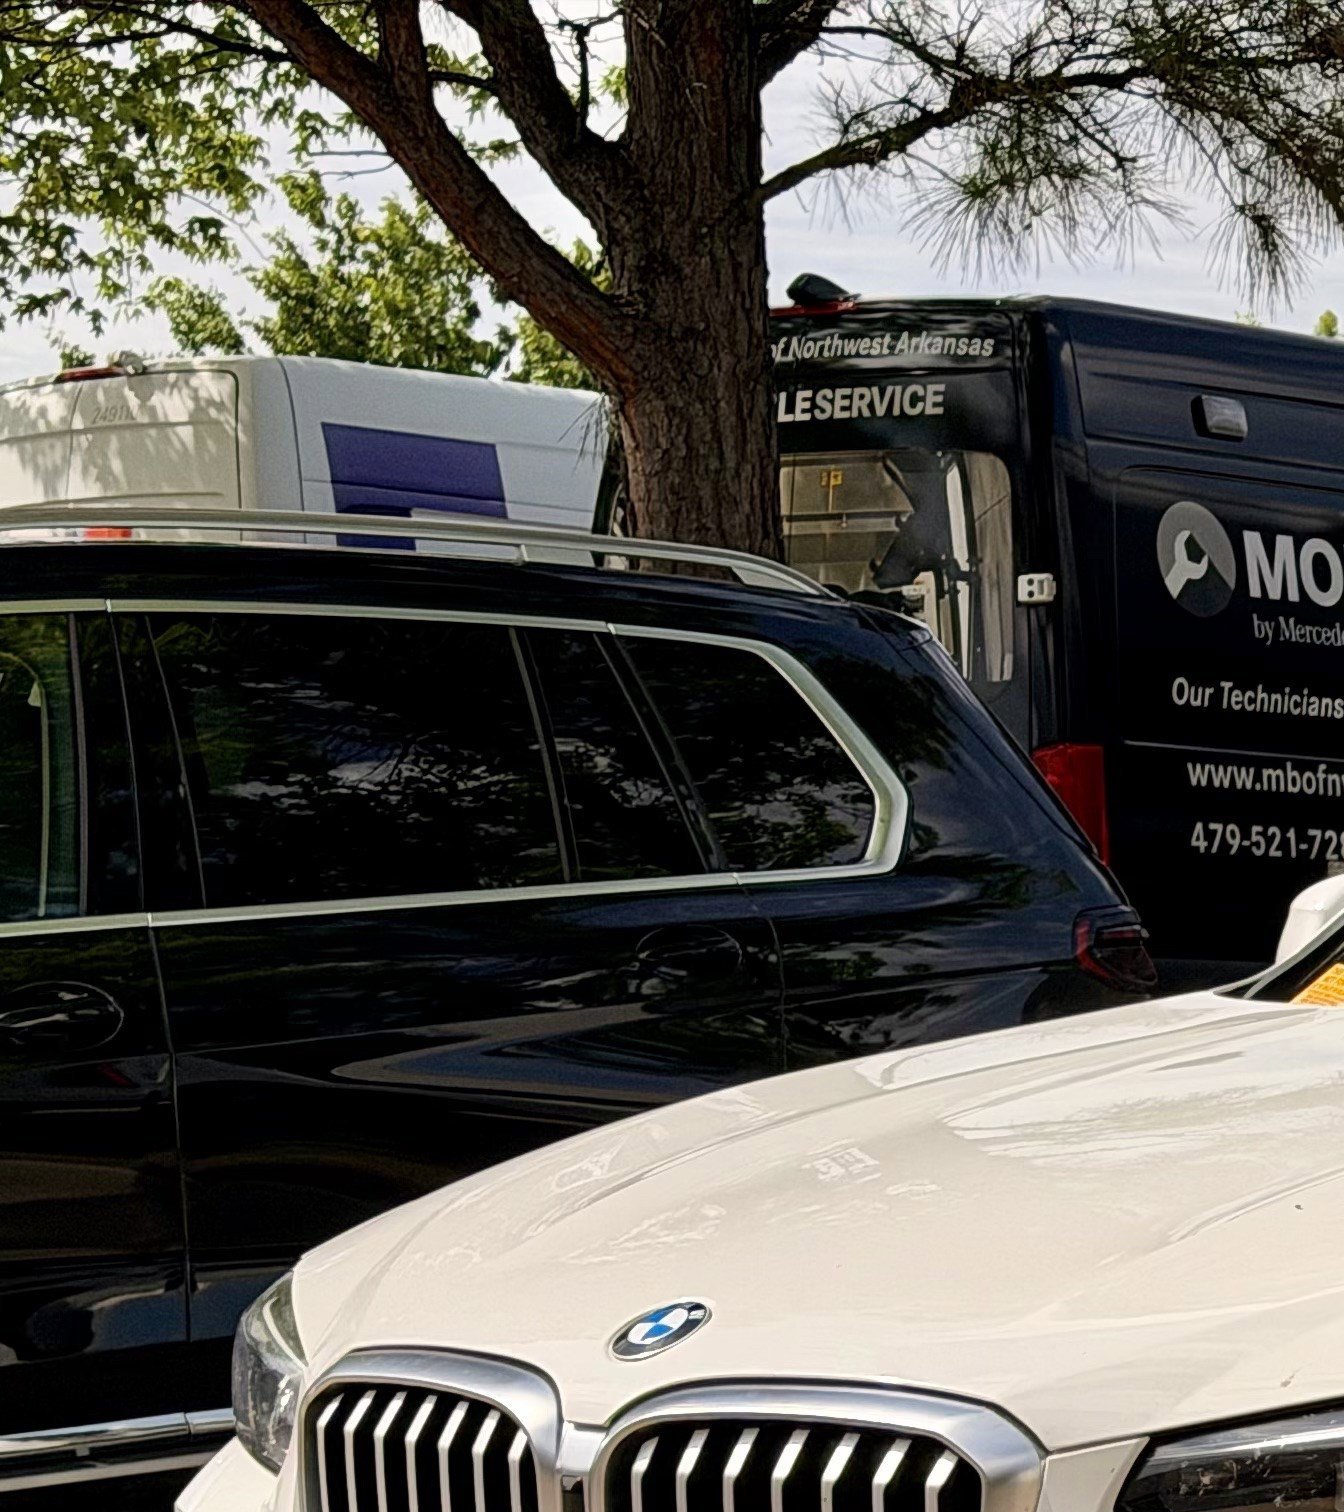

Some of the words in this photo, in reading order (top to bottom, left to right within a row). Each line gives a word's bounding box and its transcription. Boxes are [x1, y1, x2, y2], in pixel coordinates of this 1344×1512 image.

[788, 332, 891, 360] Northwest
[893, 330, 995, 357] Arkansas
[776, 383, 946, 423] LESERVICE
[1252, 613, 1276, 646] by
[1171, 676, 1214, 708] Our
